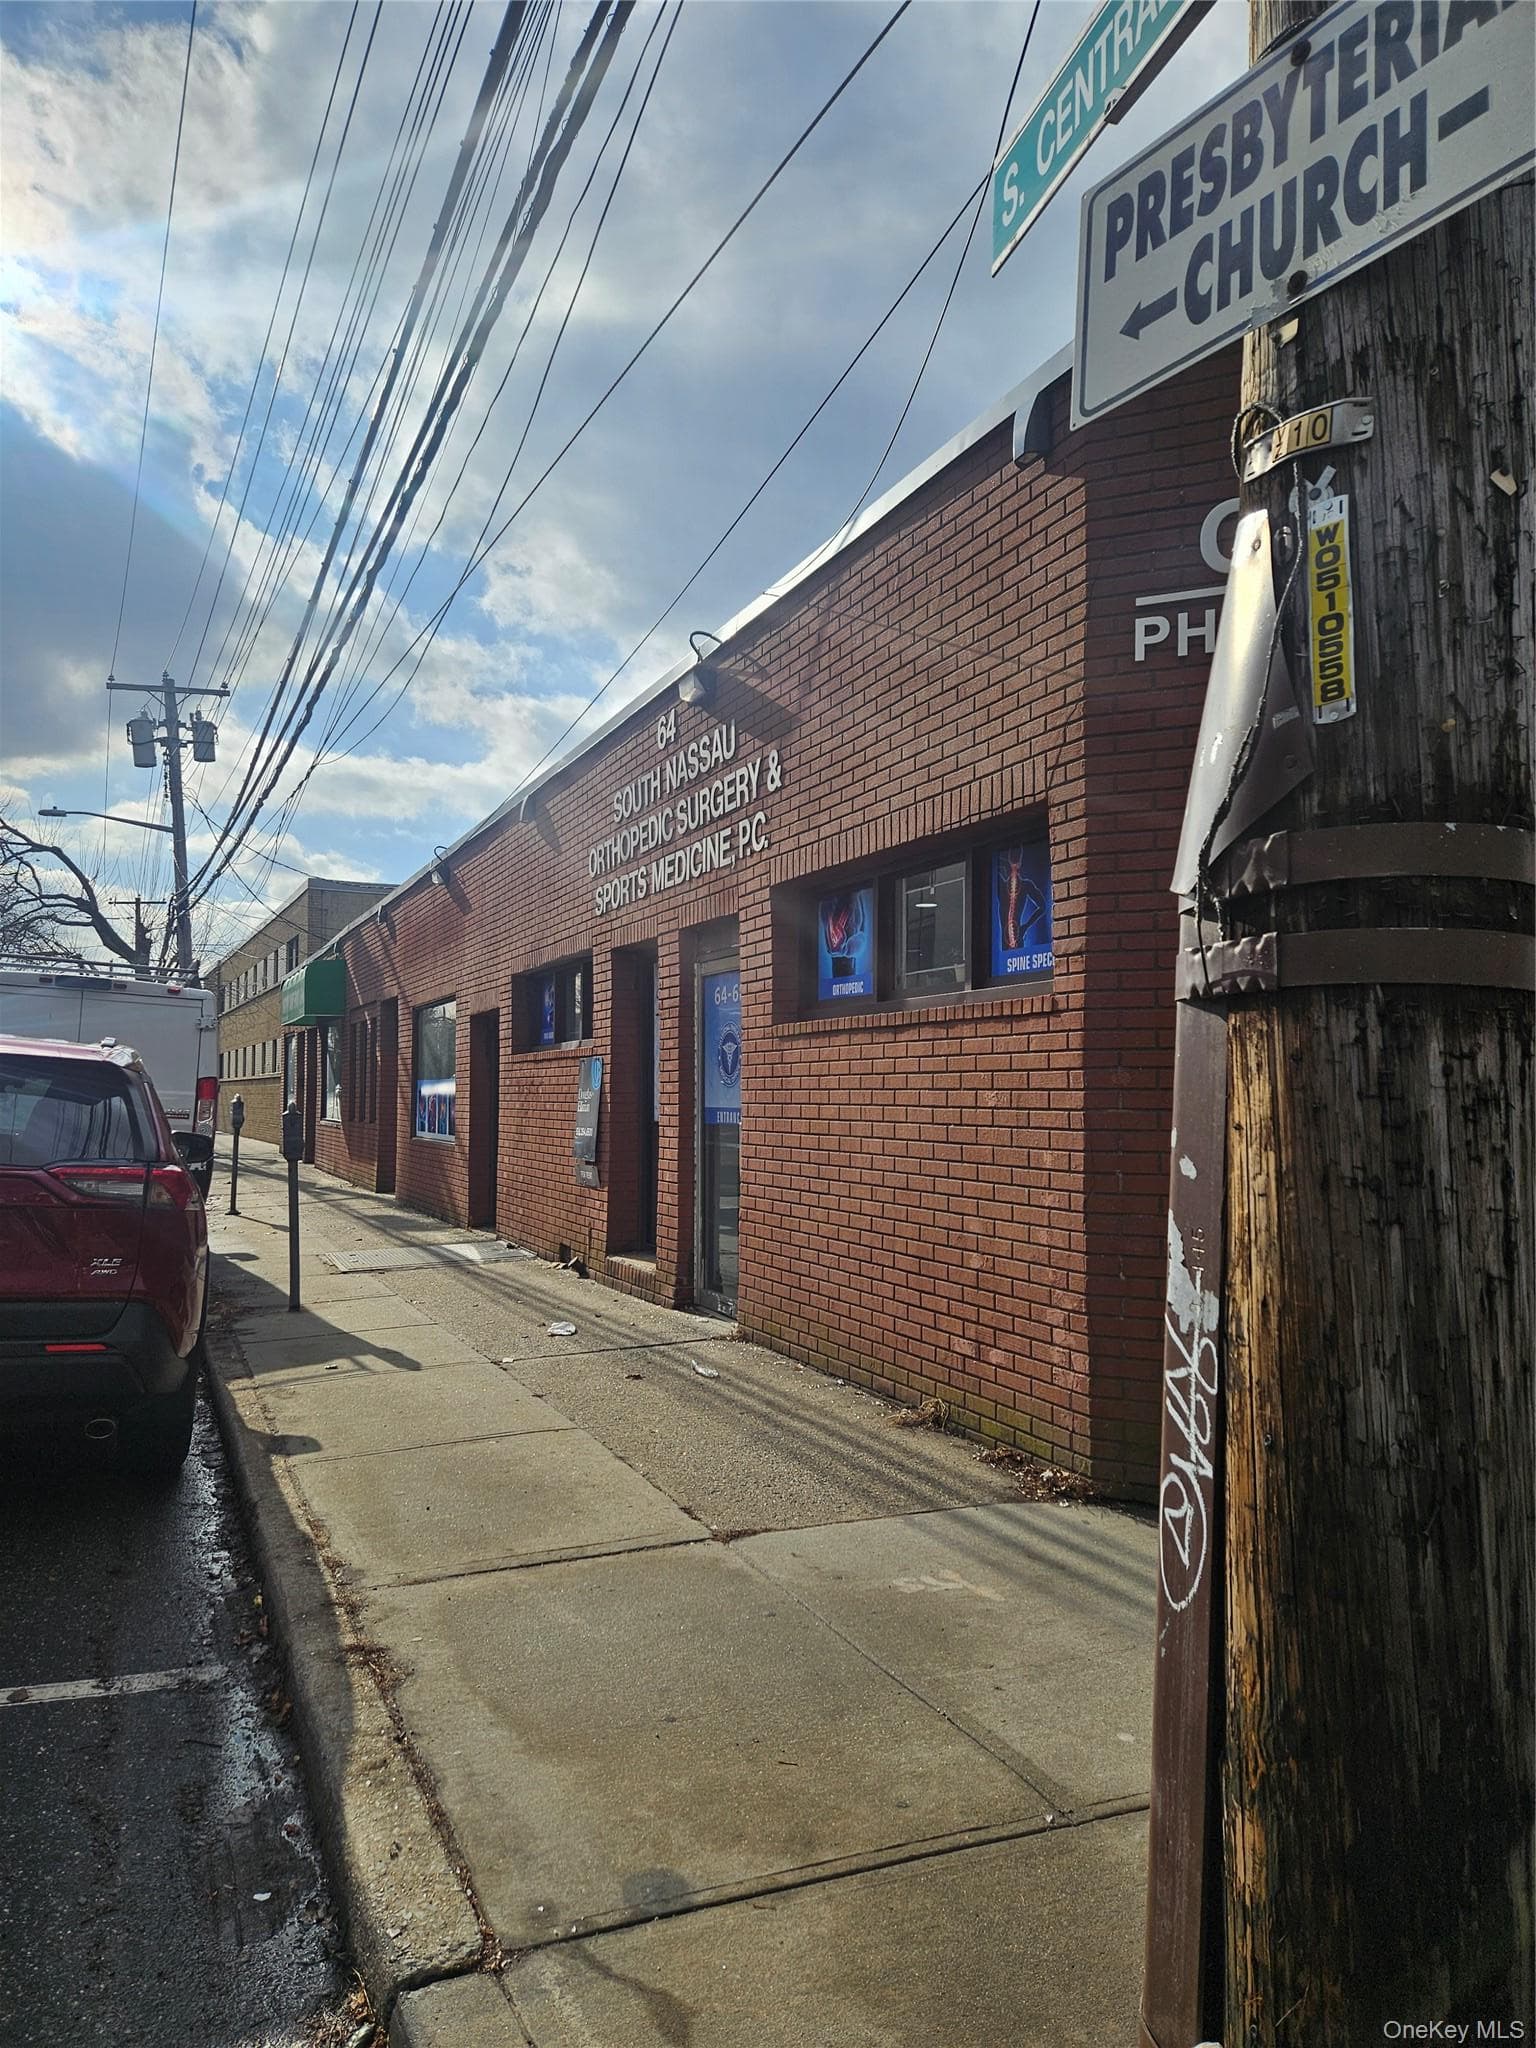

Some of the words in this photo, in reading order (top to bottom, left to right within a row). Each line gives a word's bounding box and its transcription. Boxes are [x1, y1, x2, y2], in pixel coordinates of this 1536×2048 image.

[1001, 161, 1025, 227] S.
[1036, 0, 1169, 176] CENTRA
[1104, 0, 1517, 283] PRESBYTERI
[1184, 89, 1428, 325] CHURCH
[613, 765, 661, 823] SOUTH
[666, 718, 736, 794] NASSAU
[657, 708, 677, 750] 64
[588, 806, 674, 878] ORTHOPEDIC
[677, 757, 762, 835] SURGERY
[767, 749, 782, 792] &
[595, 866, 648, 916] SPORTS
[651, 826, 736, 895] MEDICINE,
[714, 983, 740, 1005] 64-6
[832, 981, 864, 996] ORTHOPEDIC
[1007, 955, 1031, 972] SPINE
[91, 1258, 122, 1266] XLE
